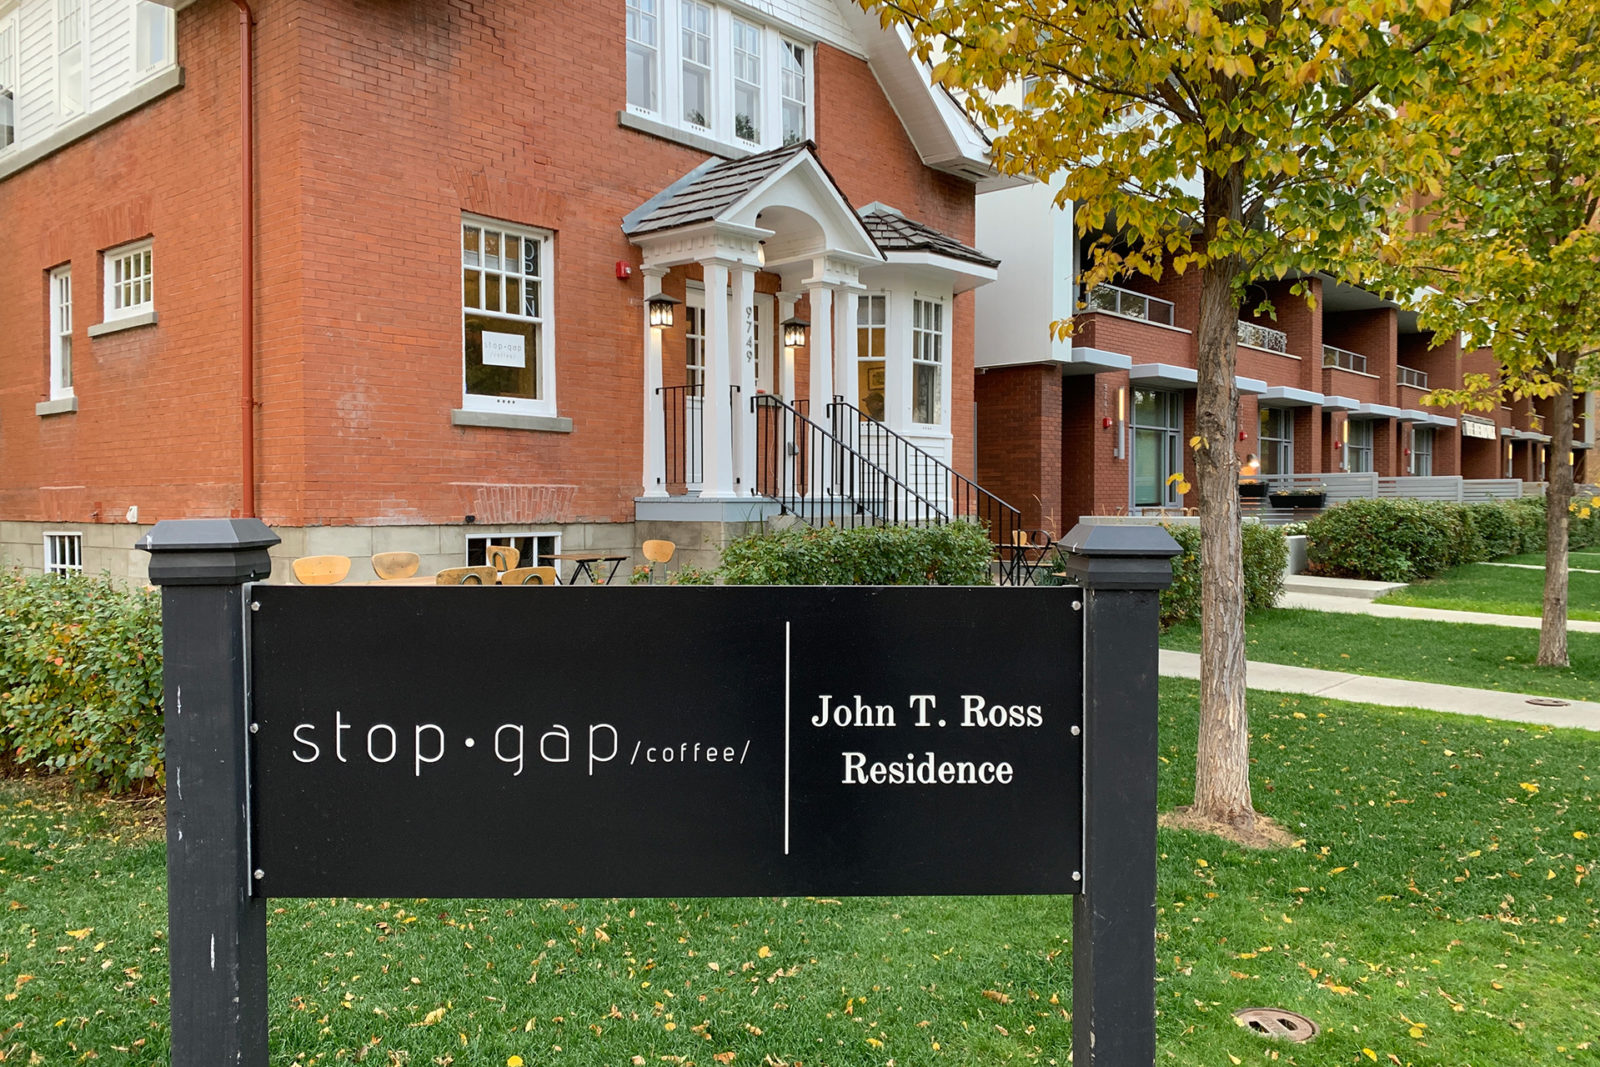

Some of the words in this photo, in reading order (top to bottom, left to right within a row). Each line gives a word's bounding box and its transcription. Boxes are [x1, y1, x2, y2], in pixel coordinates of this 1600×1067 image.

[811, 694, 897, 728] John
[909, 694, 947, 728] T.
[960, 694, 1043, 728] Ross
[841, 751, 1014, 785] Residence
